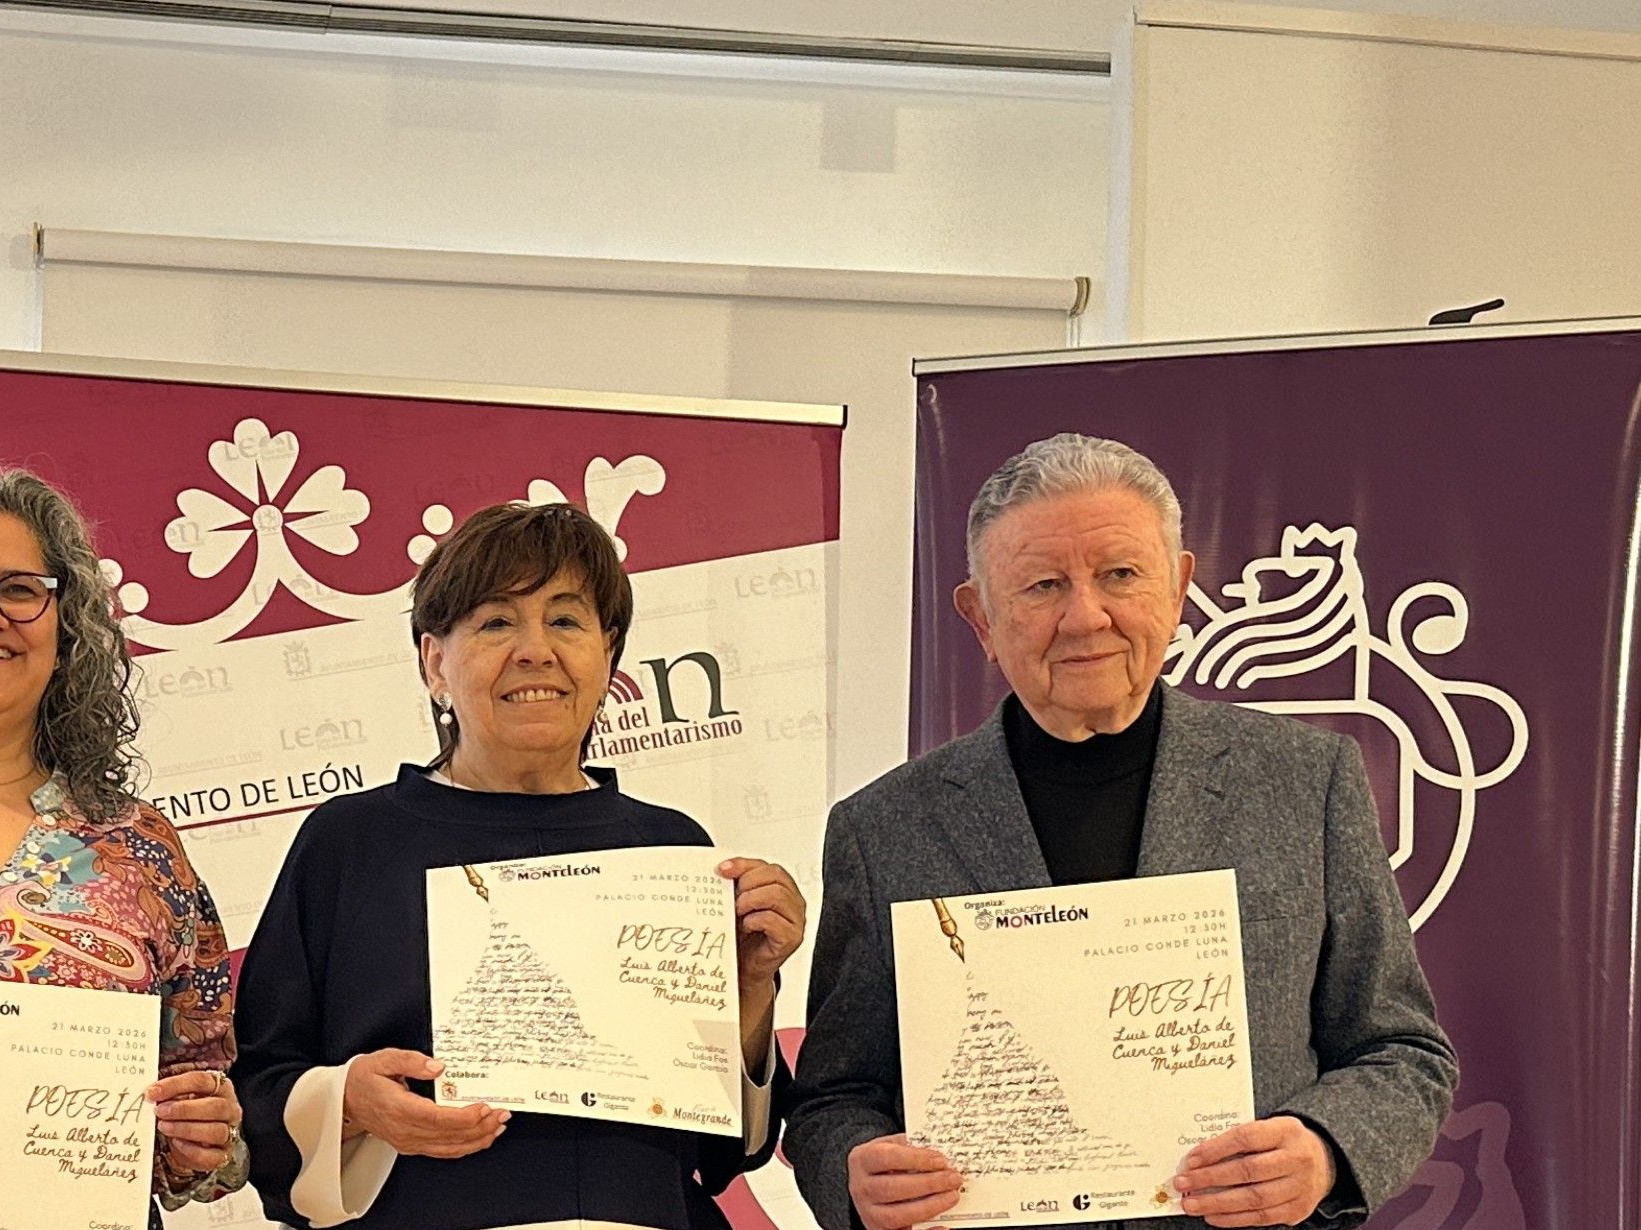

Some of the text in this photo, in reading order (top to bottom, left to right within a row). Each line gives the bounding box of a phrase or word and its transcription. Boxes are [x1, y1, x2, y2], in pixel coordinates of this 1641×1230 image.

[618, 706, 651, 732] del
[589, 715, 743, 760] rlamentarismo
[152, 786, 231, 819] ENTO
[240, 778, 279, 808] DE
[287, 762, 364, 800] LEÓN
[617, 924, 726, 959] POESÍA
[1084, 936, 1228, 957] PALACIO CONDE LUNA
[1196, 948, 1228, 960] LEÓN
[620, 957, 726, 979] Luis Alberto de
[619, 970, 727, 993] Cuenca y Daniel
[1109, 972, 1232, 1018] POESÍA
[1113, 1016, 1235, 1042] Luis Alberto de
[11, 1043, 146, 1063] PALACIO CONDE LUNA
[1112, 1032, 1237, 1060] Cuenca y Daniel
[115, 1065, 145, 1075] LEÓN
[445, 1070, 489, 1079] Colabora:
[26, 1084, 146, 1126] POESÍA
[673, 1108, 733, 1126] Montegrande
[26, 1124, 141, 1147] Luis Alberto de
[23, 1140, 141, 1163] Cuenca y Daniel
